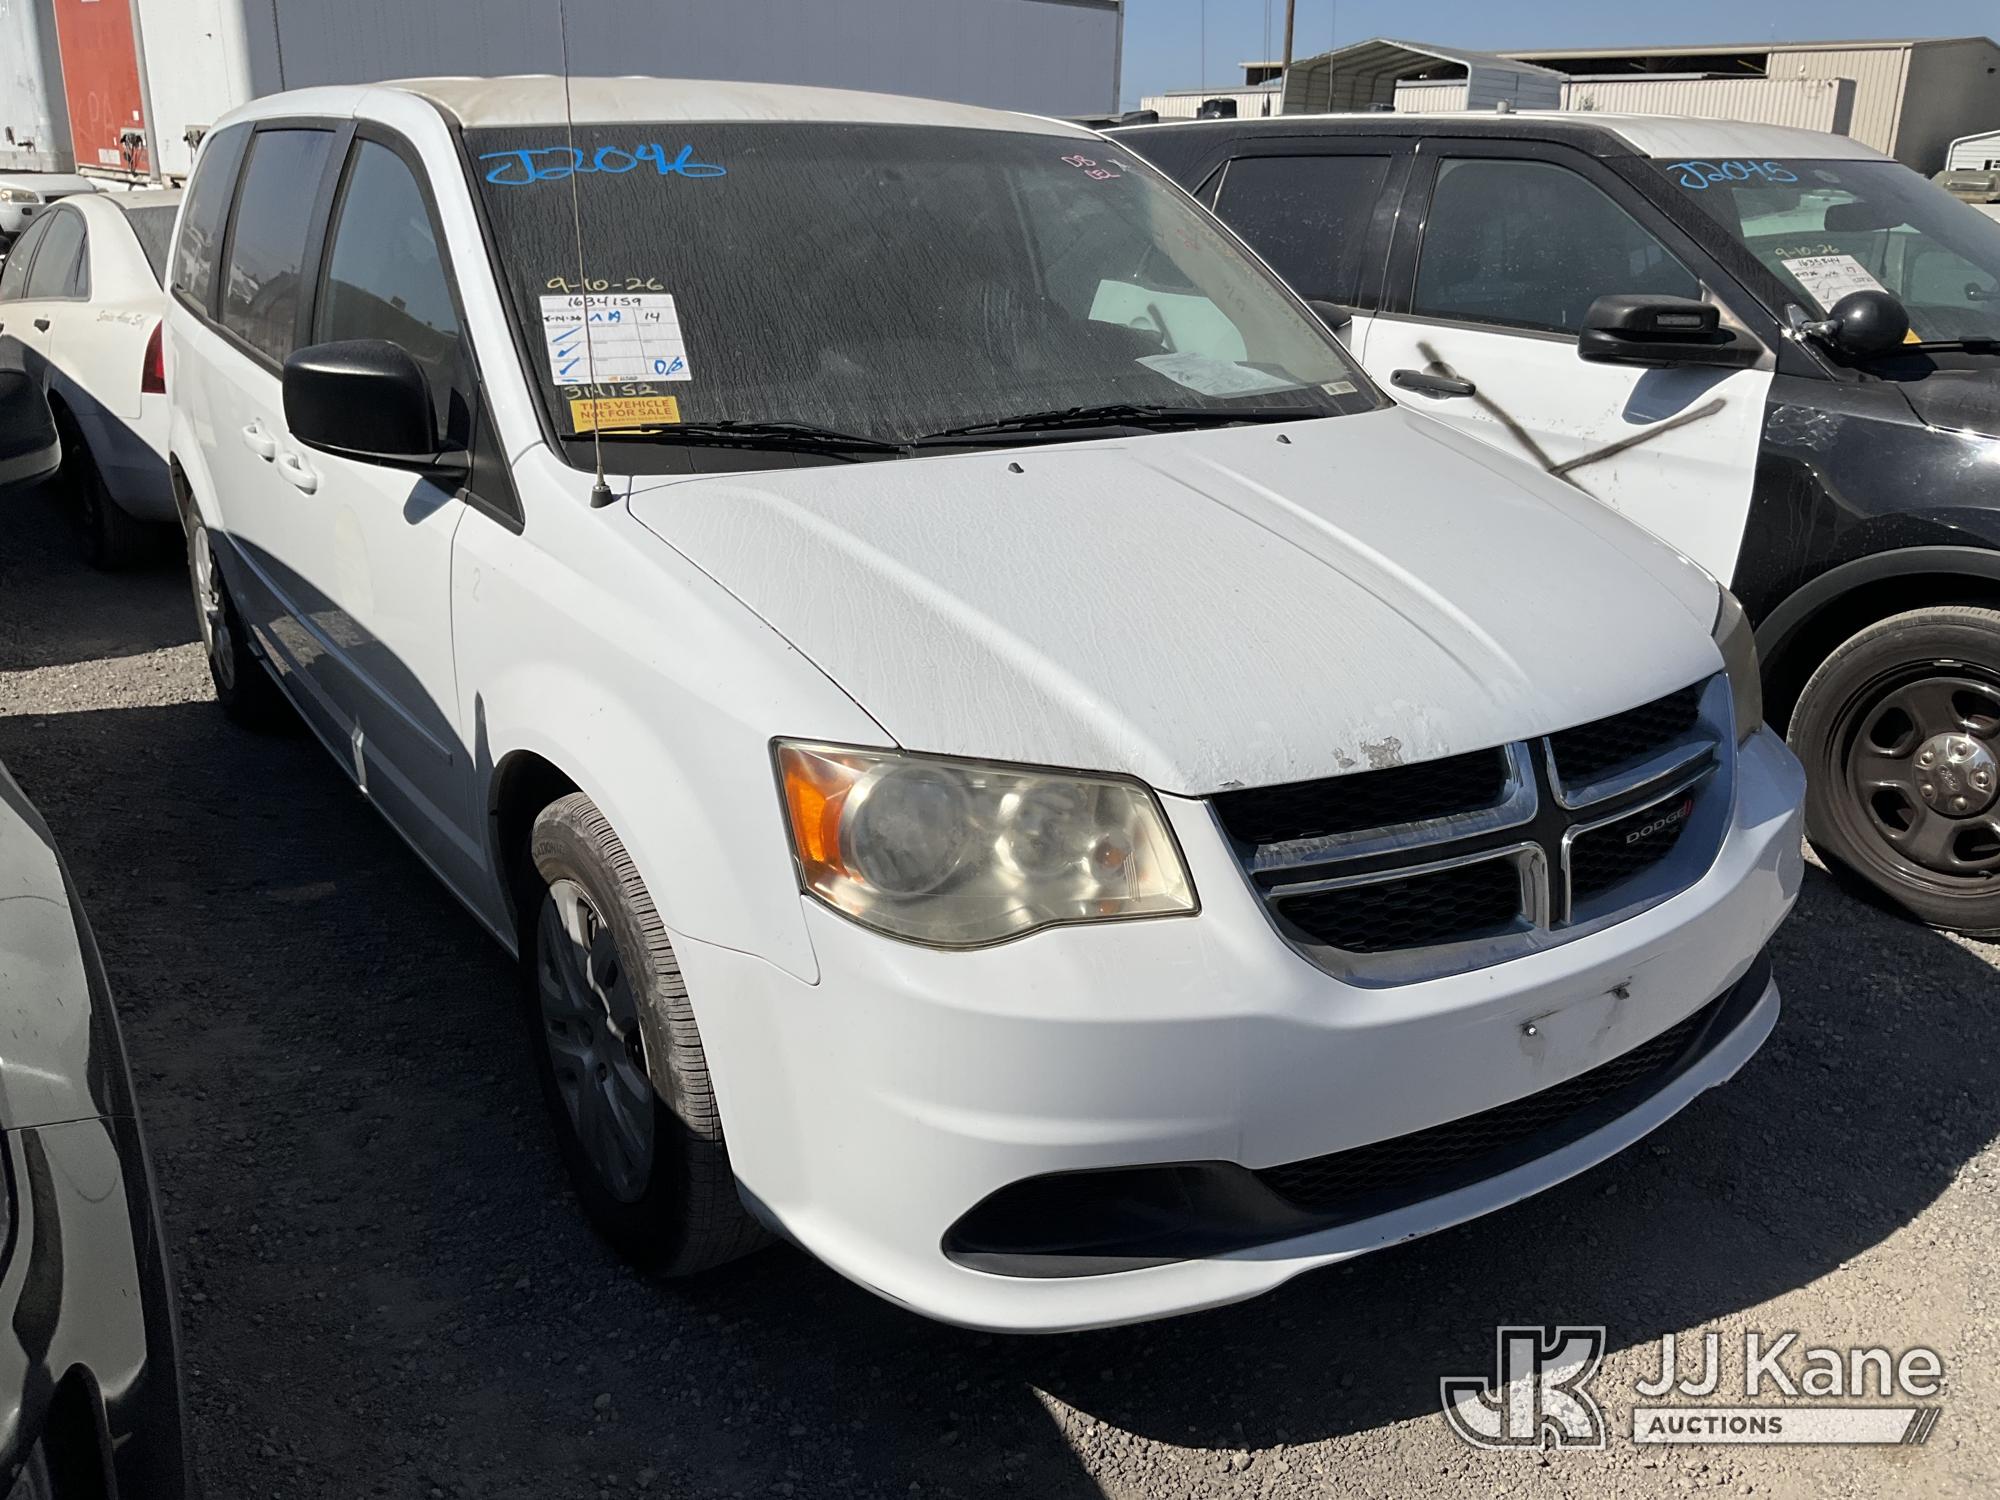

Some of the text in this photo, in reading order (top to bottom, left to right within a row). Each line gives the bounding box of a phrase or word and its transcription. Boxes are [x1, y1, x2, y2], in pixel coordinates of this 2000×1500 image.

[479, 144, 727, 185] J2046
[1666, 161, 1798, 189] J2045
[547, 277, 664, 294] 9-10-26
[568, 297, 642, 307] 1634159
[645, 312, 660, 322] 14
[580, 400, 670, 410] THIS VEHICLE
[608, 409, 635, 417] FOR
[638, 407, 672, 416] SALE
[1626, 807, 1686, 844] DODGE
